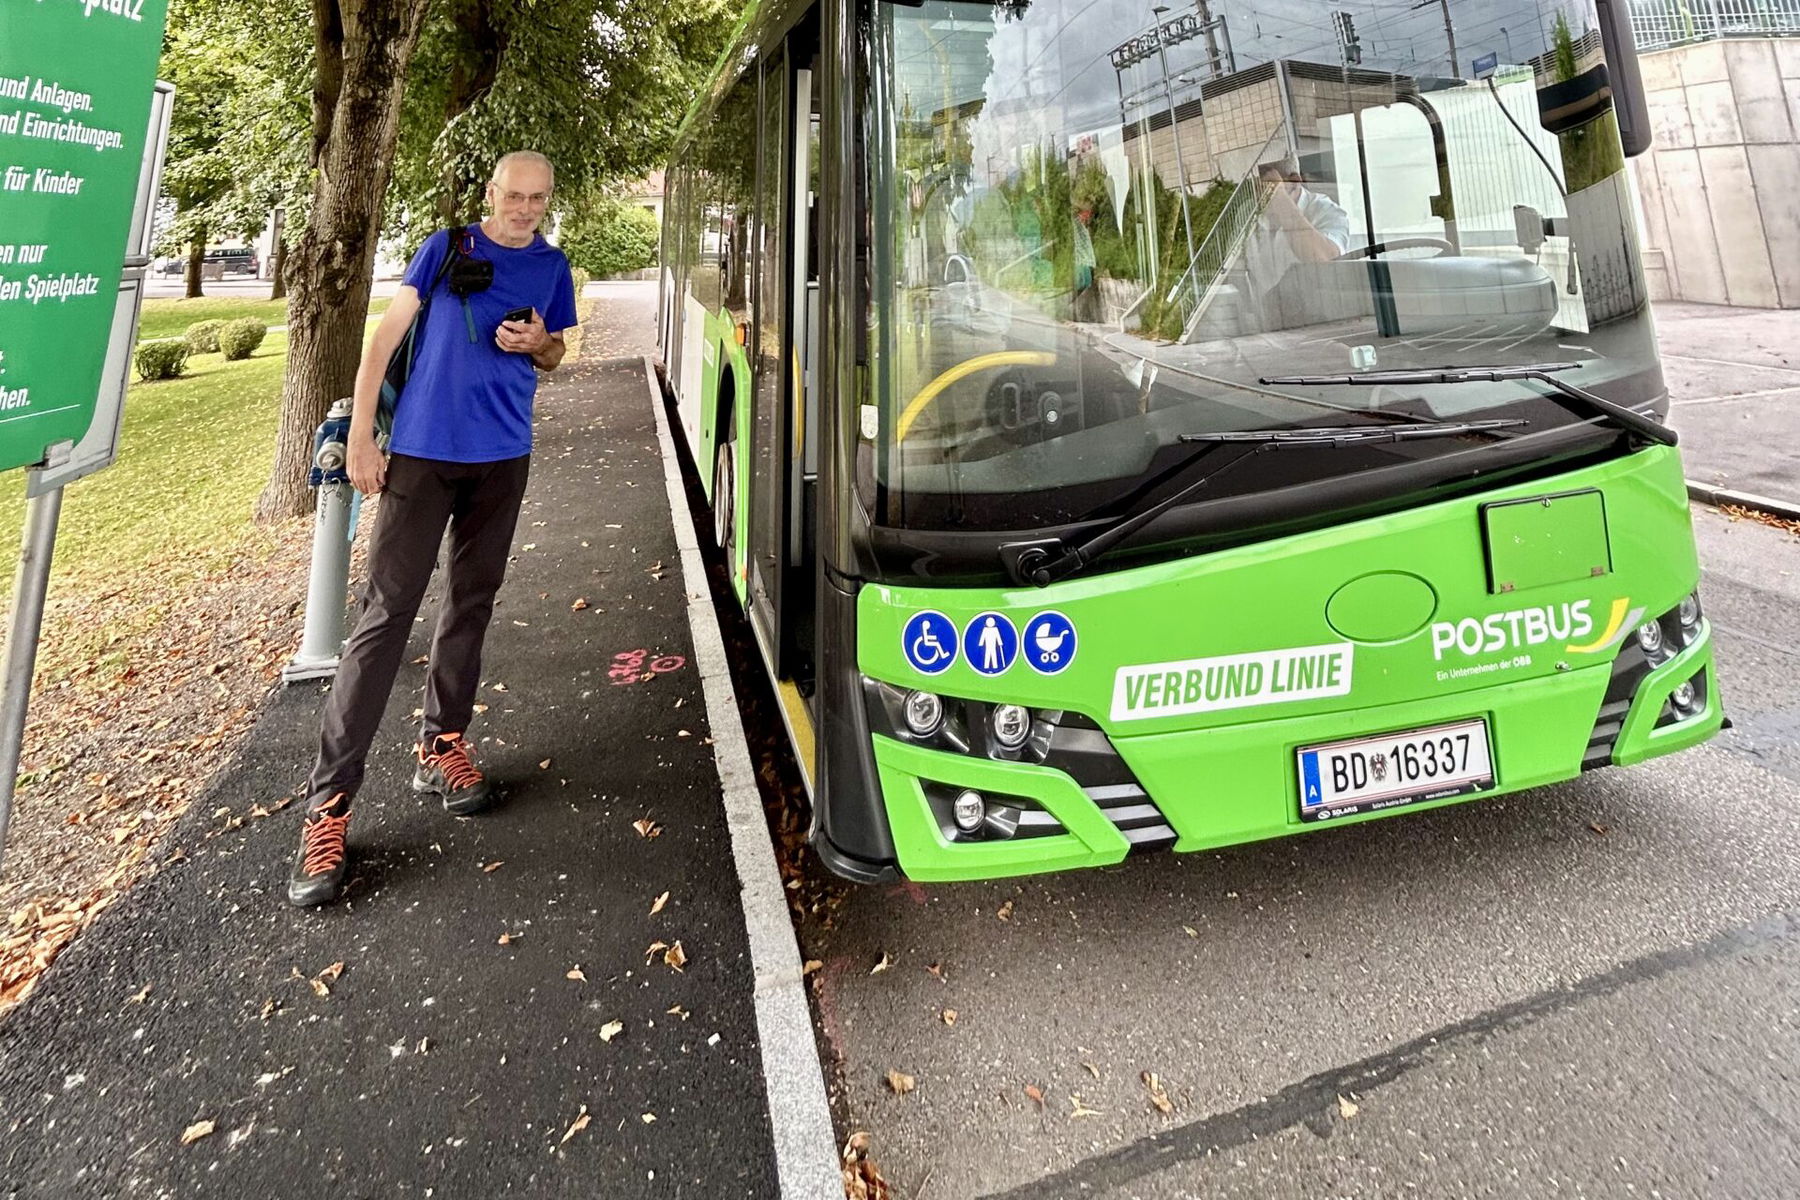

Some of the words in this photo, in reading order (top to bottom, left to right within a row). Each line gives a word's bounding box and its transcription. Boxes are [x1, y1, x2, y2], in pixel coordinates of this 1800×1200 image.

[0, 75, 30, 100] und
[30, 78, 94, 113] Anlagen.
[22, 111, 124, 152] Einrichtungen.
[3, 166, 31, 191] für
[33, 168, 84, 195] Kinder
[18, 244, 48, 264] nur
[25, 272, 100, 305] Spielplatz
[1431, 599, 1593, 661] POSTBUS
[1126, 661, 1264, 710] VERBUND
[1271, 652, 1343, 693] LINIE
[1436, 671, 1449, 681] Ein
[1450, 662, 1499, 679] Unternehmen
[1500, 659, 1512, 669] der
[1331, 751, 1368, 794] BD
[1390, 733, 1470, 783] 16337
[1309, 784, 1318, 798] A
[1332, 805, 1359, 816] SOLARIS
